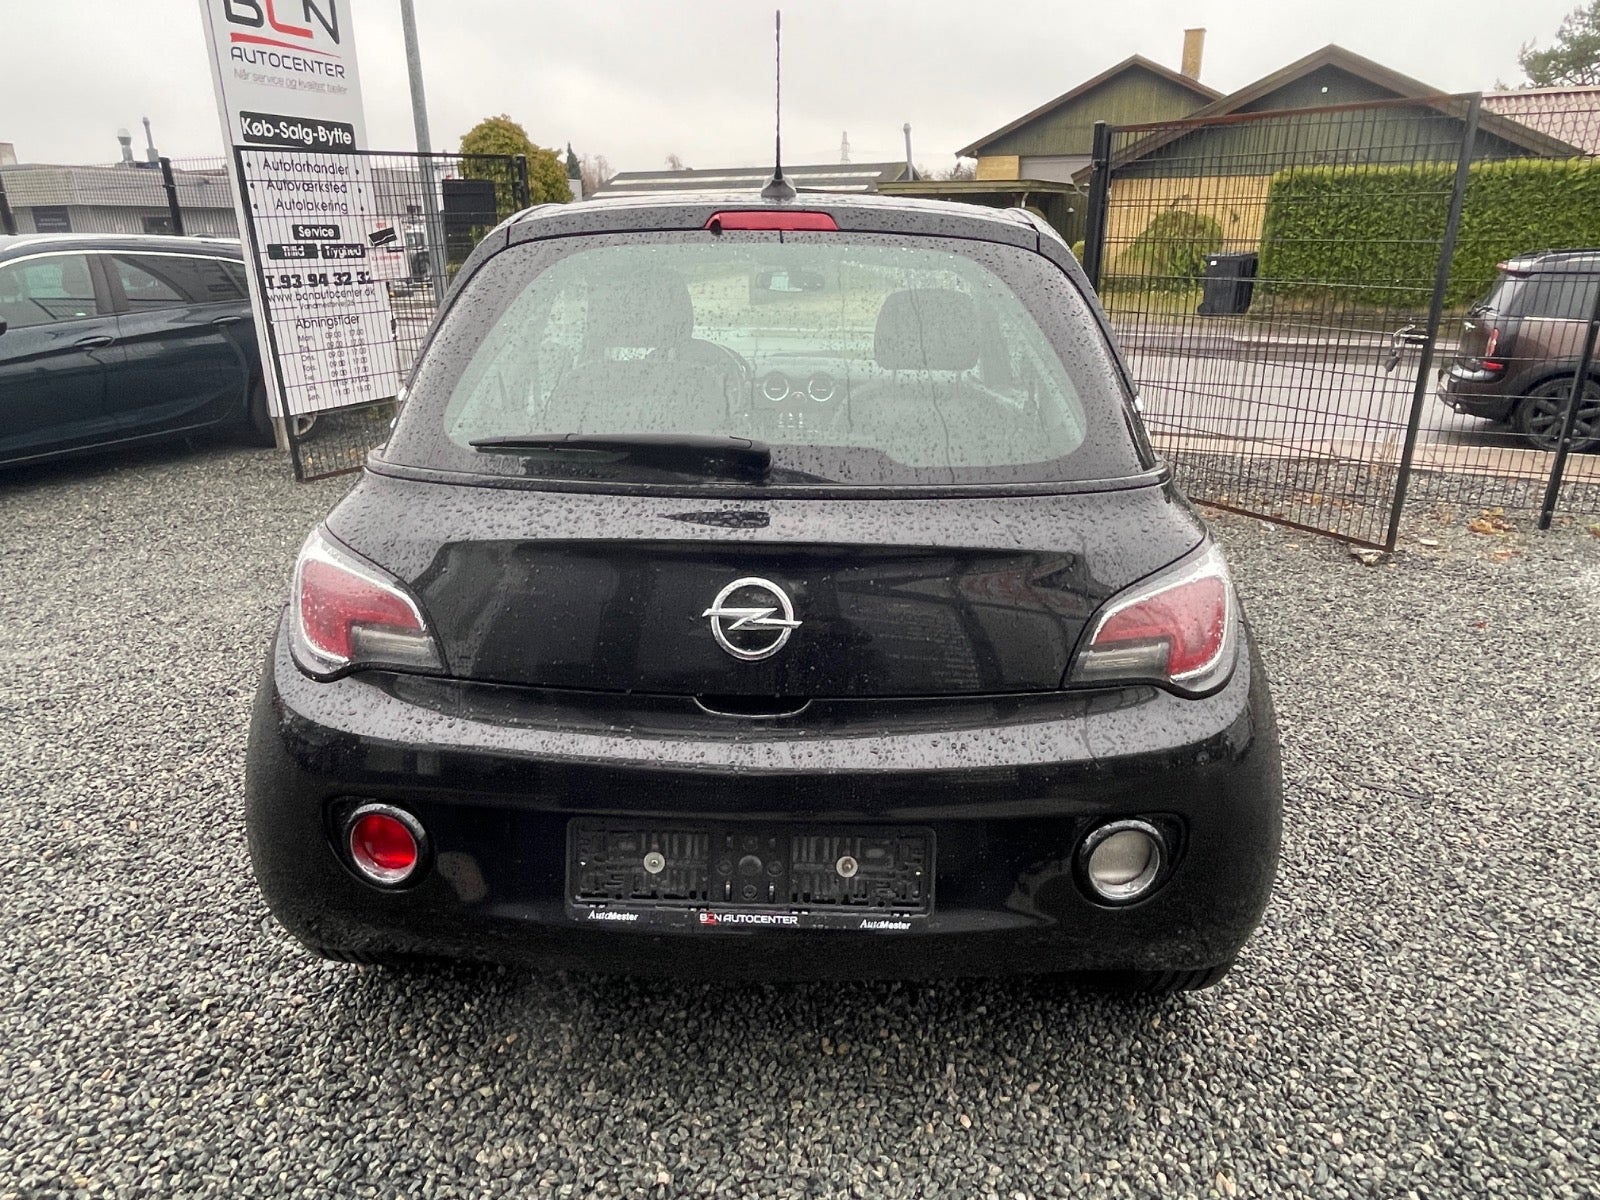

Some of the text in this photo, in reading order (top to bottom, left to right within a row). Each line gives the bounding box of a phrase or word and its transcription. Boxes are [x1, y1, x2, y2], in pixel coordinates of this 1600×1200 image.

[231, 47, 345, 79] AUTOCENTER
[241, 117, 352, 146] Køb-Salg-Bytte
[262, 159, 349, 175] Autoforhandler
[266, 179, 348, 194] Autoværksted
[275, 198, 348, 214] Autolakering
[298, 226, 335, 237] Service
[324, 245, 361, 258] Tryghed
[307, 273, 328, 288] 94
[333, 272, 352, 286] 32
[295, 314, 360, 330] Åbningstider
[723, 914, 798, 925] AUTOCENTER
[860, 918, 912, 930] AutoMester
